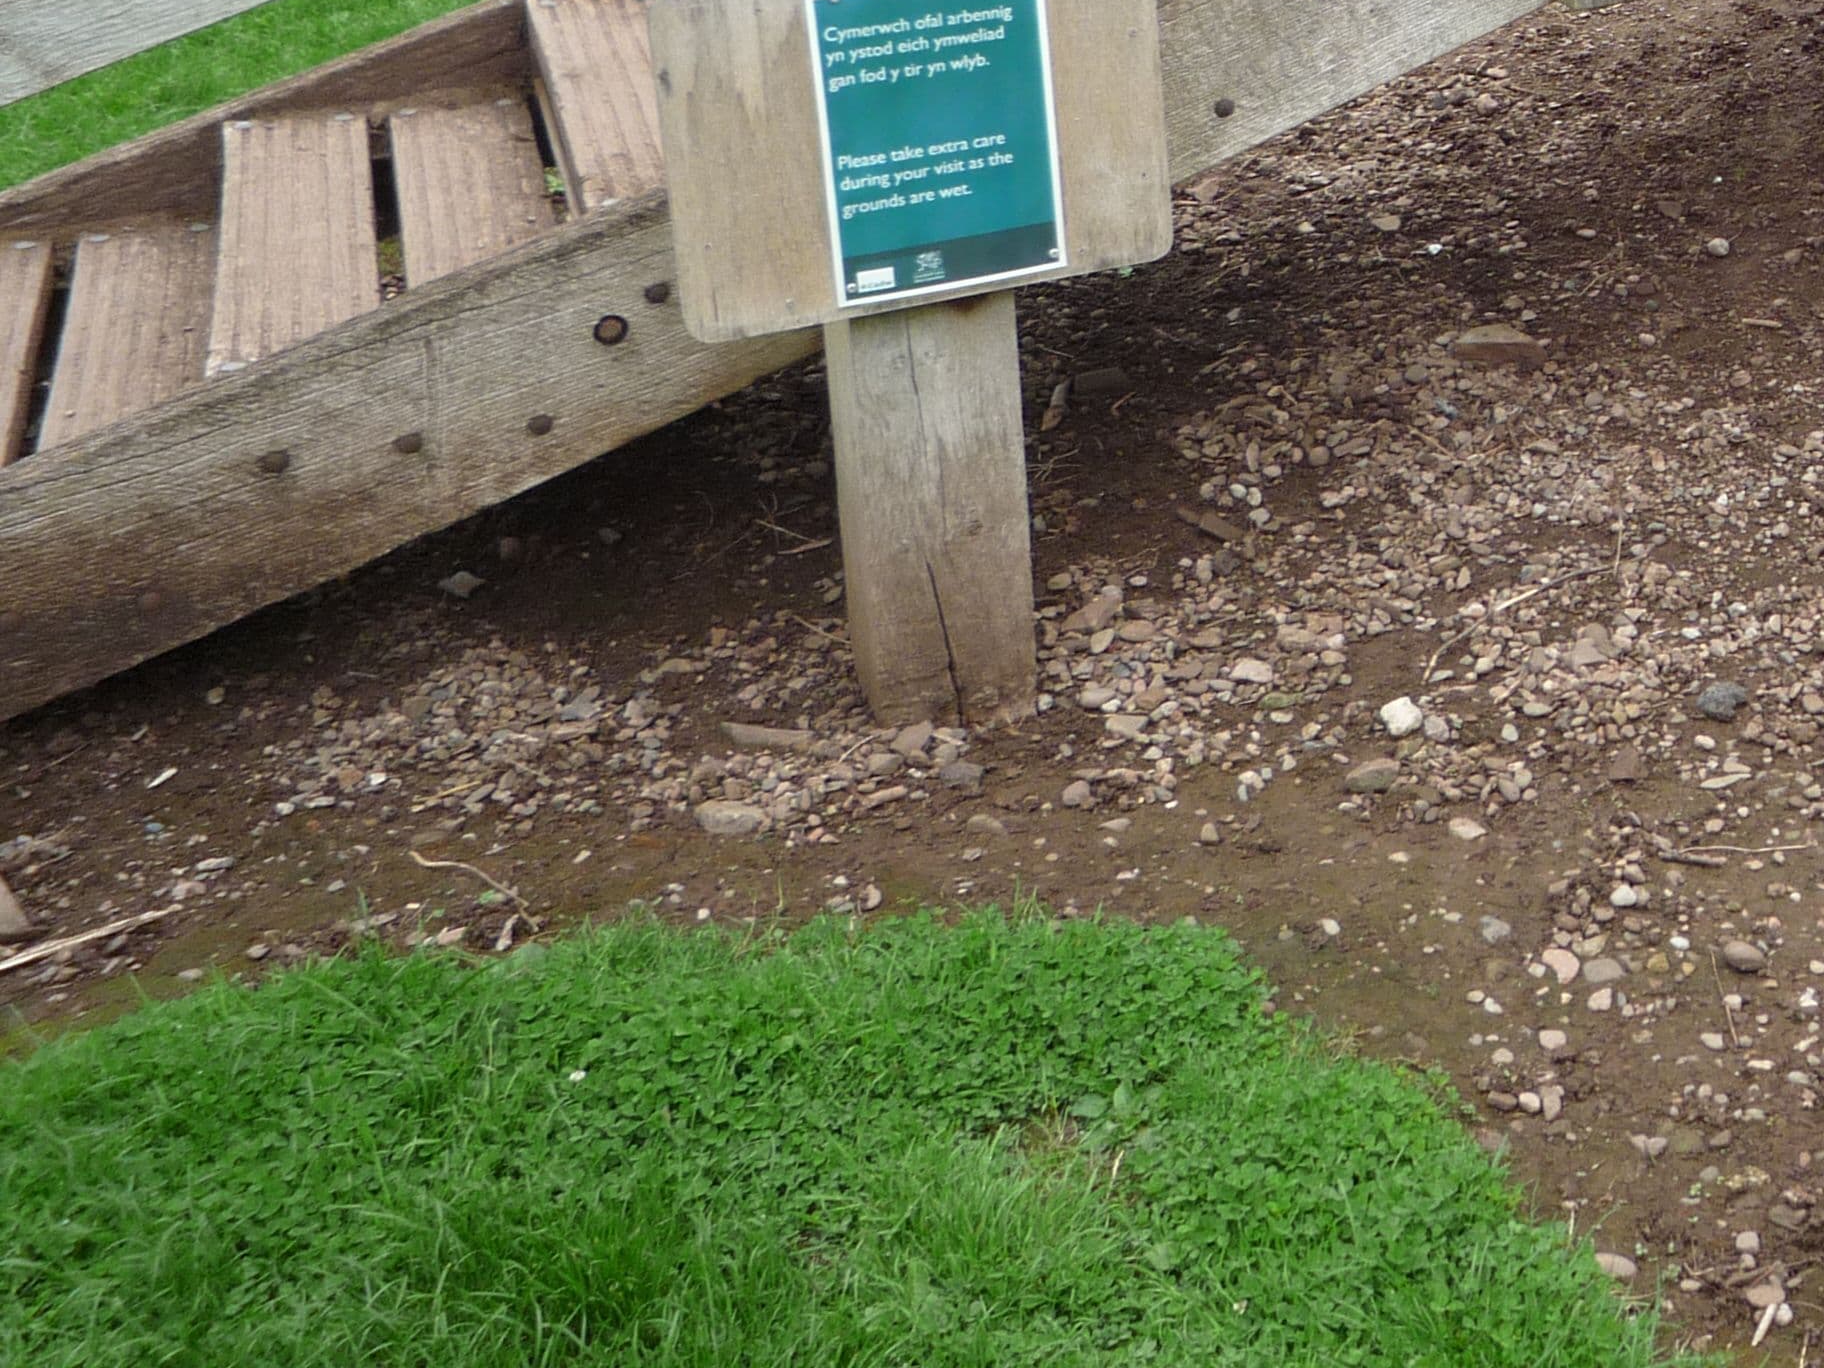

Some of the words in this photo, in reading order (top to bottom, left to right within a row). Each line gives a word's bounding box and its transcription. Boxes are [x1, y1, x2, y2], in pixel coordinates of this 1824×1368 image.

[824, 18, 910, 43] Cymerwch
[914, 13, 943, 30] ofal
[947, 6, 1013, 25] arbennig
[825, 51, 845, 67] yn
[849, 41, 893, 64] ystod
[898, 37, 929, 52] eich
[934, 26, 1005, 52] ymweliad
[828, 75, 855, 92] gan
[860, 69, 886, 83] fod
[890, 69, 900, 82] y
[904, 63, 923, 77] tir
[927, 61, 946, 78] yn
[950, 54, 990, 72] wlyb.
[837, 152, 886, 170] Please
[890, 146, 924, 162] take
[928, 140, 969, 155] extra
[972, 134, 1006, 149] care
[840, 173, 890, 191] during
[893, 167, 930, 185] your
[934, 160, 965, 175] visit
[968, 156, 984, 169] as
[988, 152, 1013, 166] the
[842, 194, 905, 220] grounds
[909, 190, 935, 204] are
[939, 184, 973, 198] wet.
